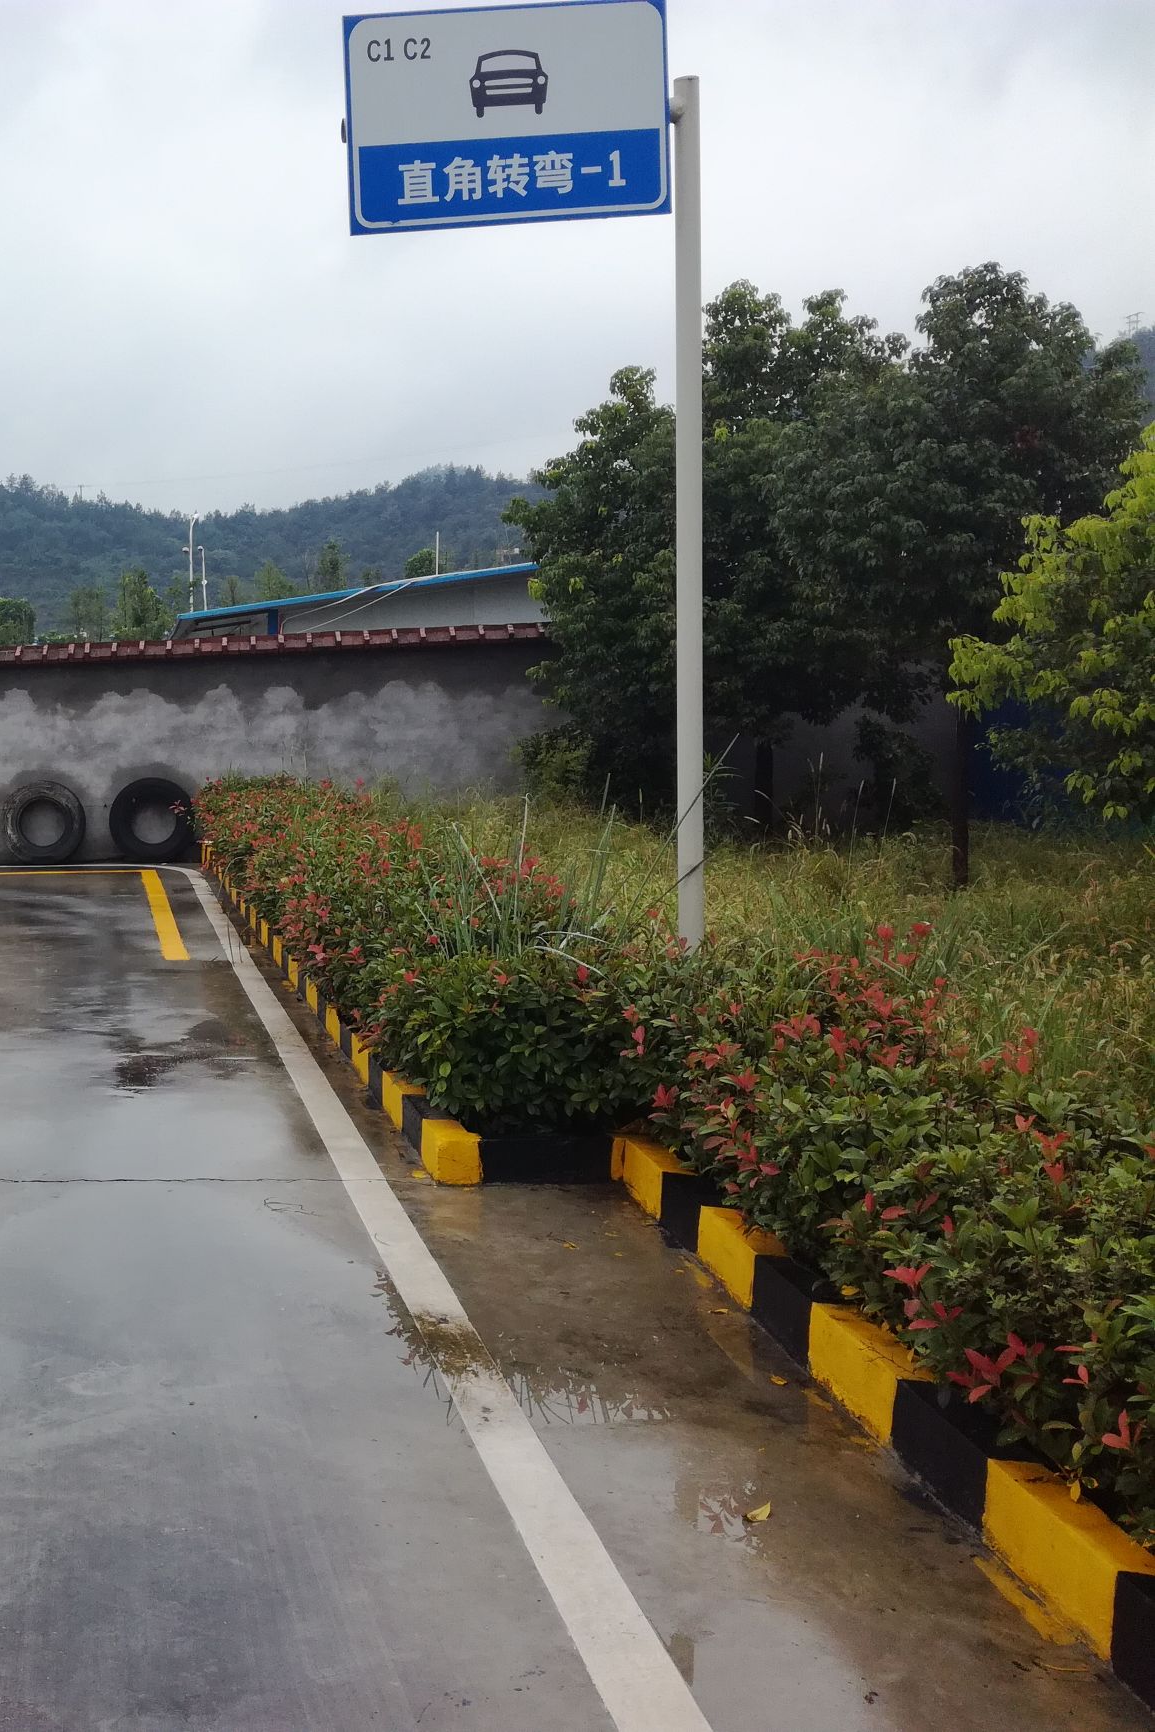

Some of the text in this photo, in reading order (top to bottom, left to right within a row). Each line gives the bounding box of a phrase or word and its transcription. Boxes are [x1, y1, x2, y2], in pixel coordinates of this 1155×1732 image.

[366, 37, 432, 63] C1 C2
[397, 150, 627, 206] 直角转弯-1
